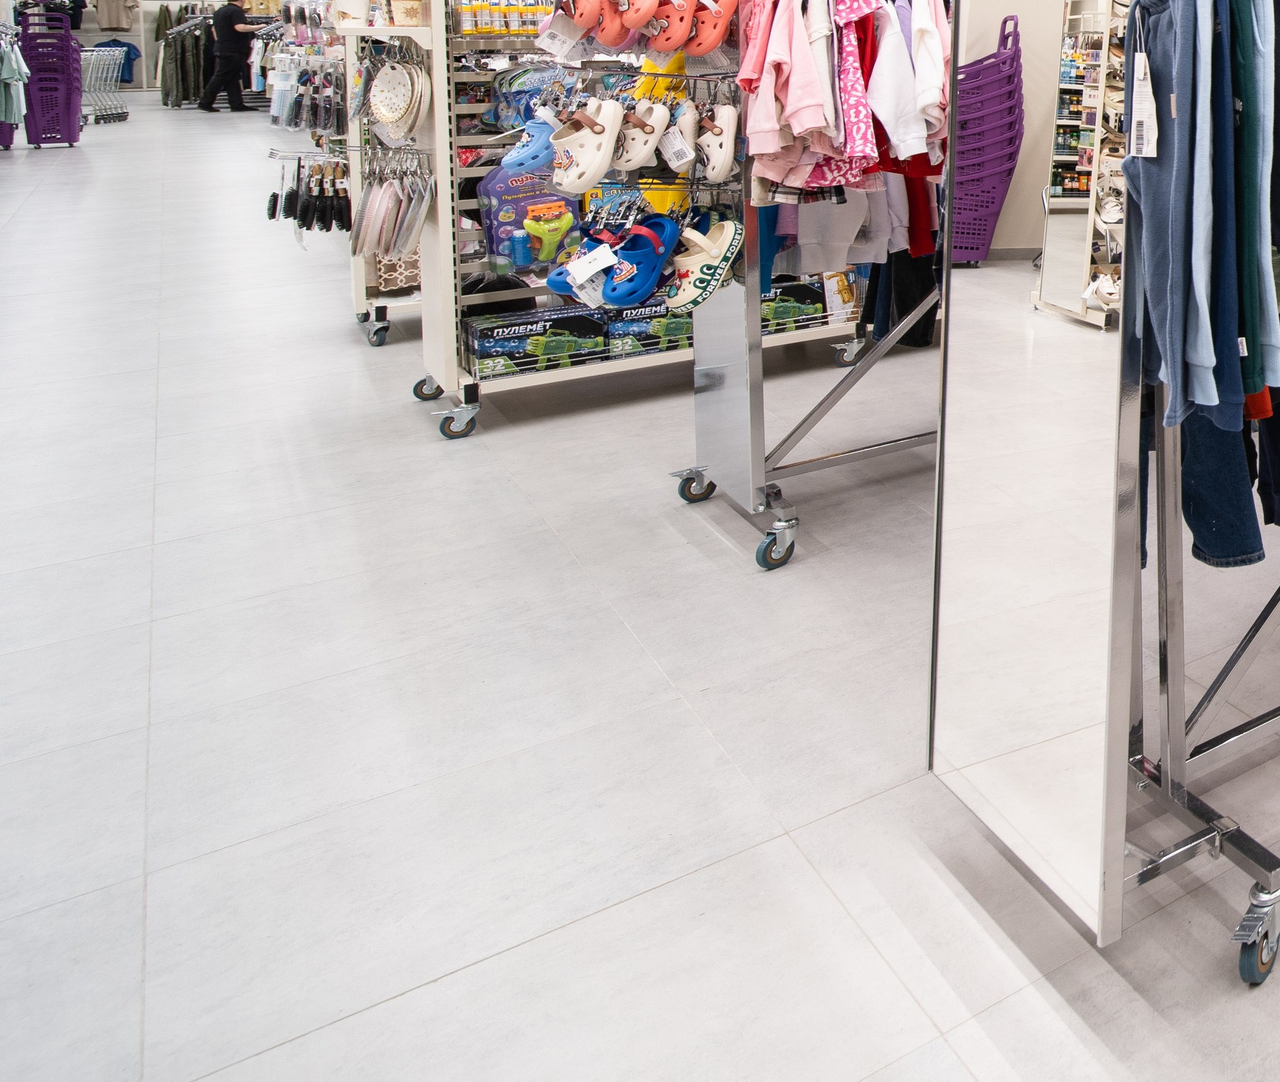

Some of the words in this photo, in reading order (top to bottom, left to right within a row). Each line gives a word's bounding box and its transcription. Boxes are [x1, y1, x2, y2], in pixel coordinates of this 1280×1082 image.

[696, 261, 728, 304] FOREVER
[622, 303, 668, 318] ПУЛЕМЁ
[493, 320, 553, 338] ПУЛЕМЁТ
[613, 338, 634, 352] 32
[483, 358, 506, 373] 32
